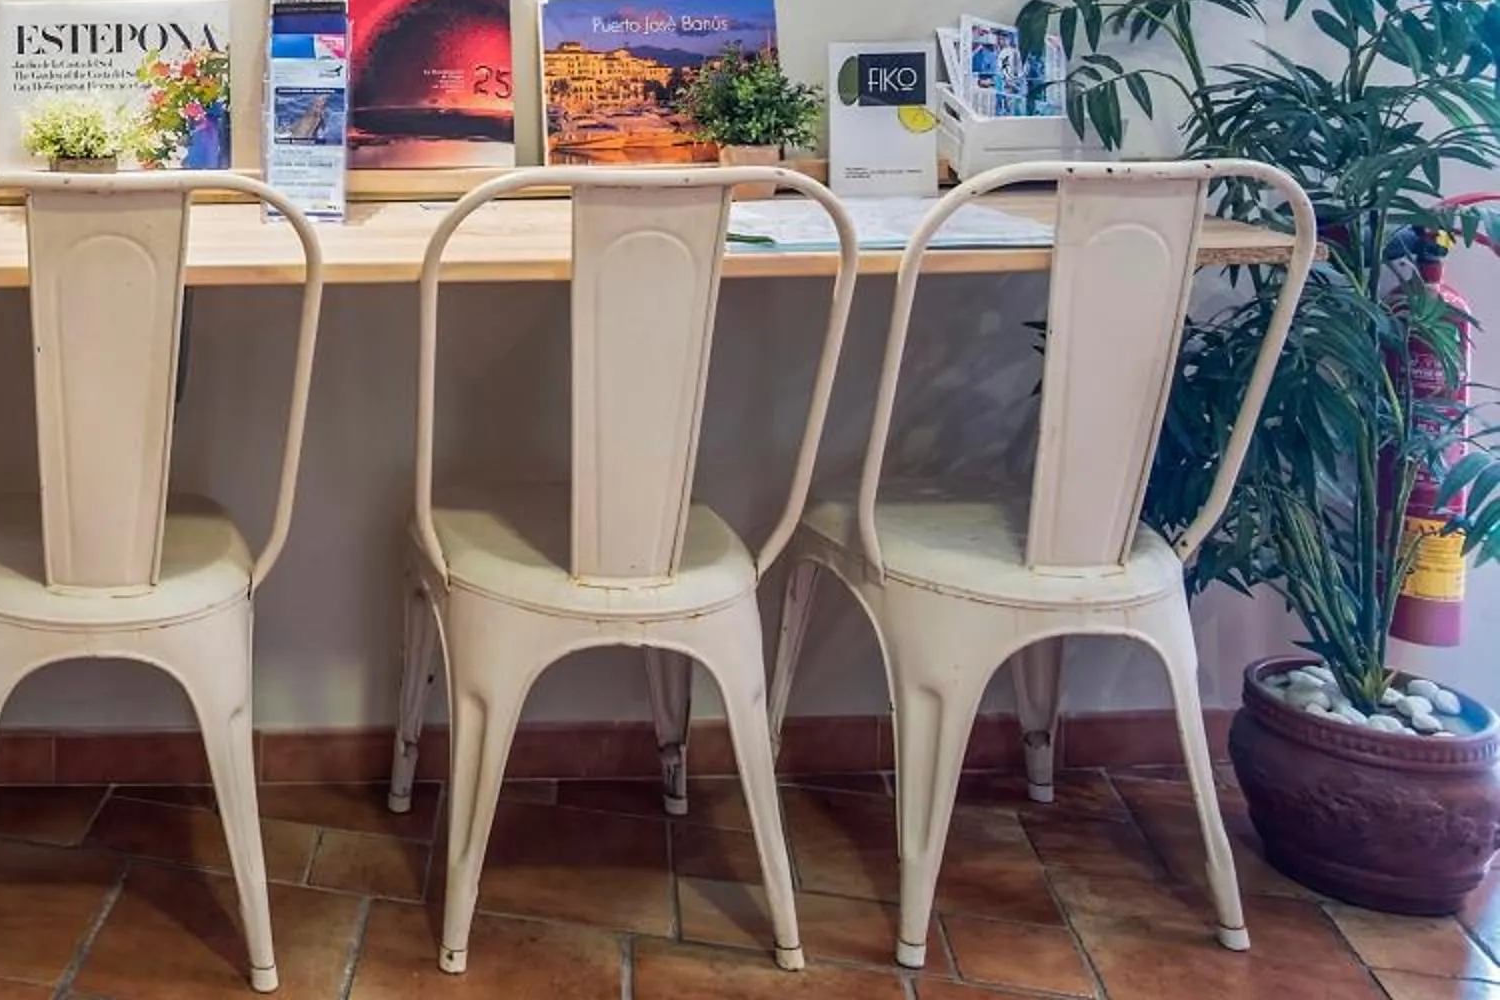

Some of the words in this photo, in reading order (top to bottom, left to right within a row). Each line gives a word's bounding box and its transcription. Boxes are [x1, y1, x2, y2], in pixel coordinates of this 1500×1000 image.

[592, 16, 641, 33] Puerto
[681, 14, 729, 32] Banús
[15, 22, 222, 55] ESTEPONA
[867, 66, 918, 93] FIKO
